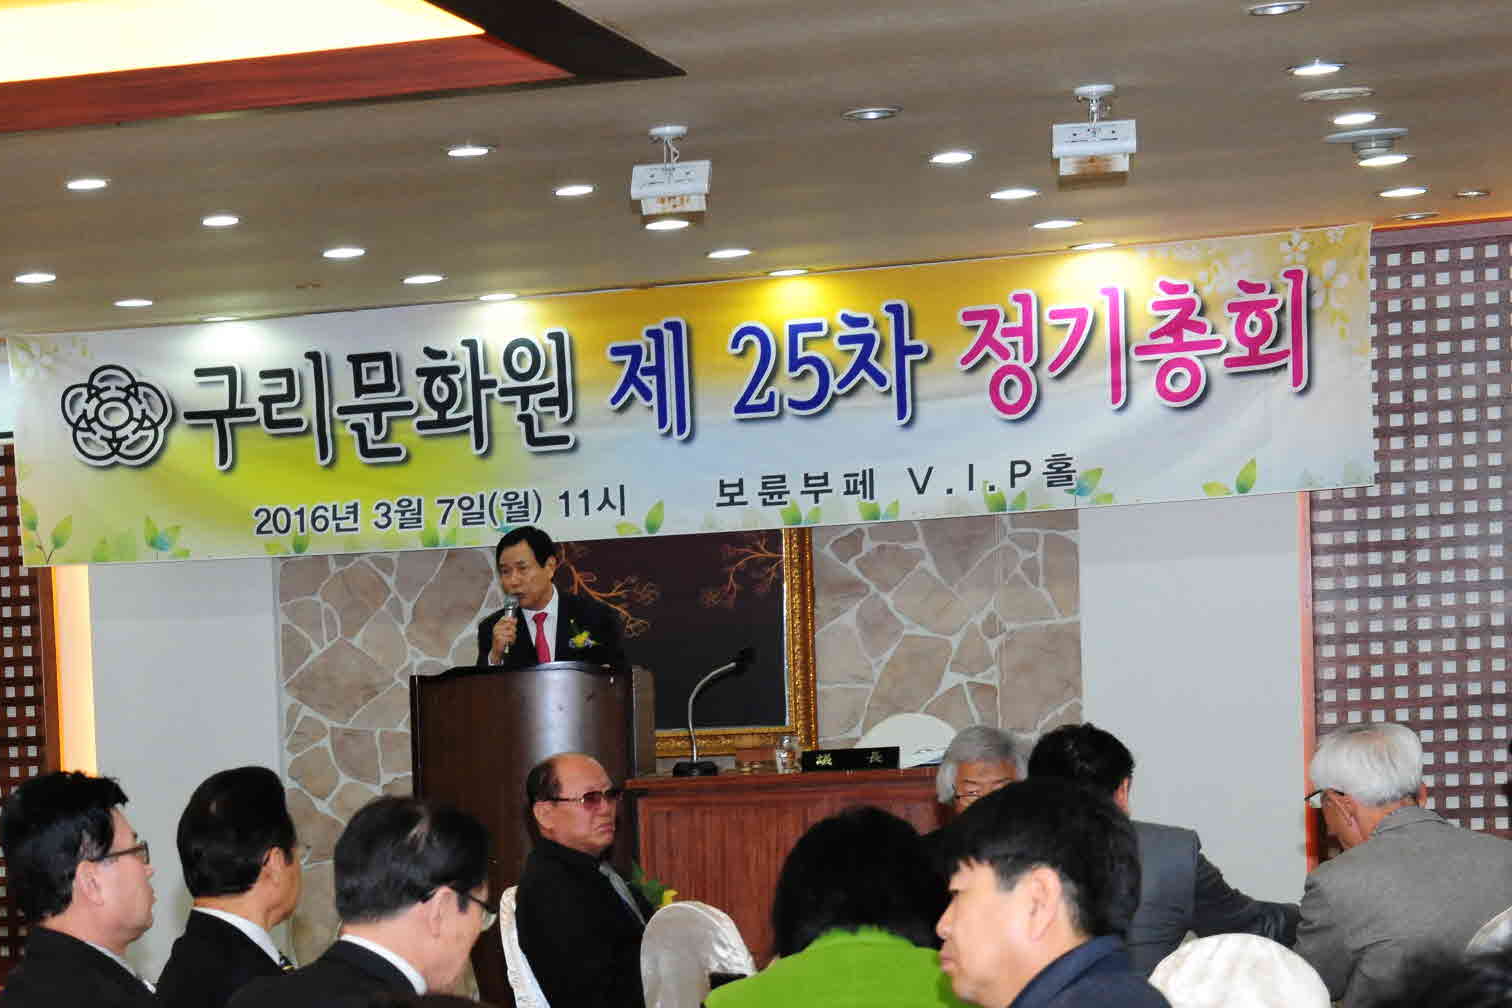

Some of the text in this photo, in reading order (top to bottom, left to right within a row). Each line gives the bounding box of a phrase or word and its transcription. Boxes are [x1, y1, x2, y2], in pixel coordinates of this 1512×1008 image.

[182, 267, 1313, 468] 구리문화원 제 25차 정기총회
[254, 484, 626, 536] 2016년 3월 7일(월) 11시
[715, 468, 877, 509] 보륜부페
